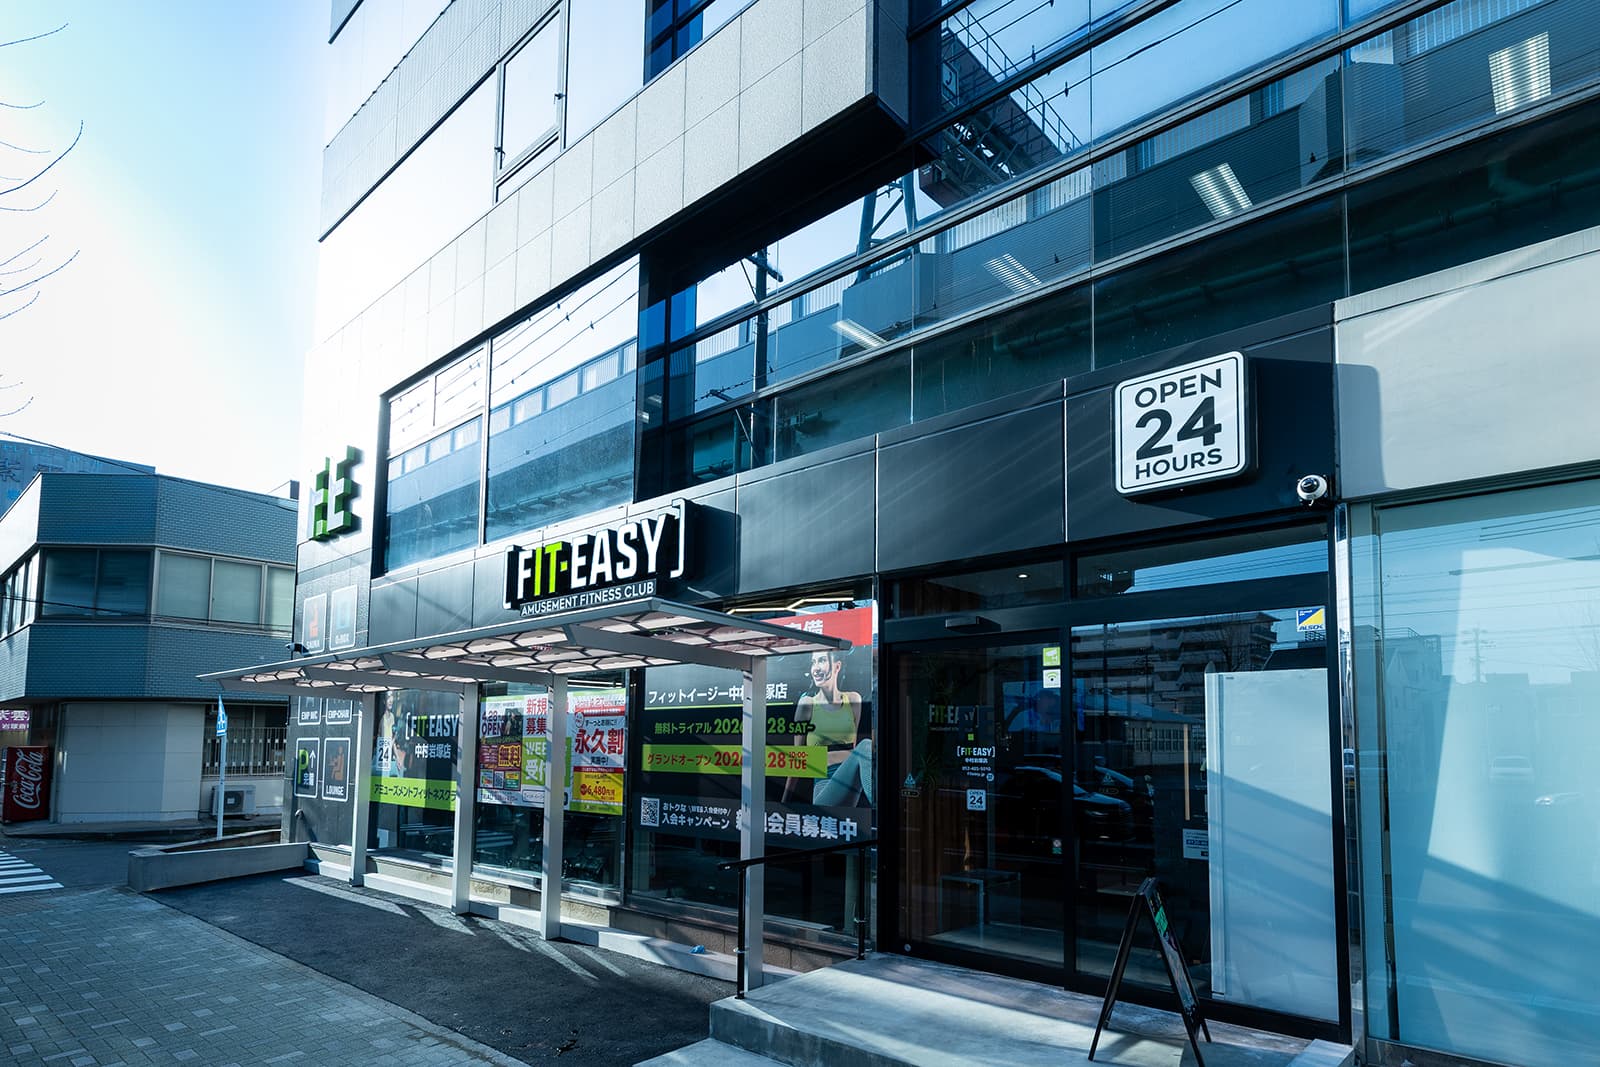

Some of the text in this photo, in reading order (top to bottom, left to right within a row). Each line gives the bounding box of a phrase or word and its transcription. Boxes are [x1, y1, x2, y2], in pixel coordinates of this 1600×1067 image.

[1135, 368, 1222, 408] OPEN
[1135, 396, 1222, 461] 24
[1136, 448, 1222, 480] HOURS
[521, 581, 654, 617] AMUSEMENT FITNESS CLUB
[526, 717, 547, 735] 募集
[655, 721, 712, 734] 無料トライアル
[575, 728, 624, 755] 永久割
[414, 743, 452, 759] 中村岩塚店
[647, 753, 712, 766] グランドオープン
[298, 749, 309, 785] P
[789, 758, 807, 769] TUE
[13, 748, 44, 809] Coca-Cola
[326, 785, 345, 795] LOUNGE
[970, 795, 984, 805] 24
[661, 812, 730, 829] 入会キャンペーン
